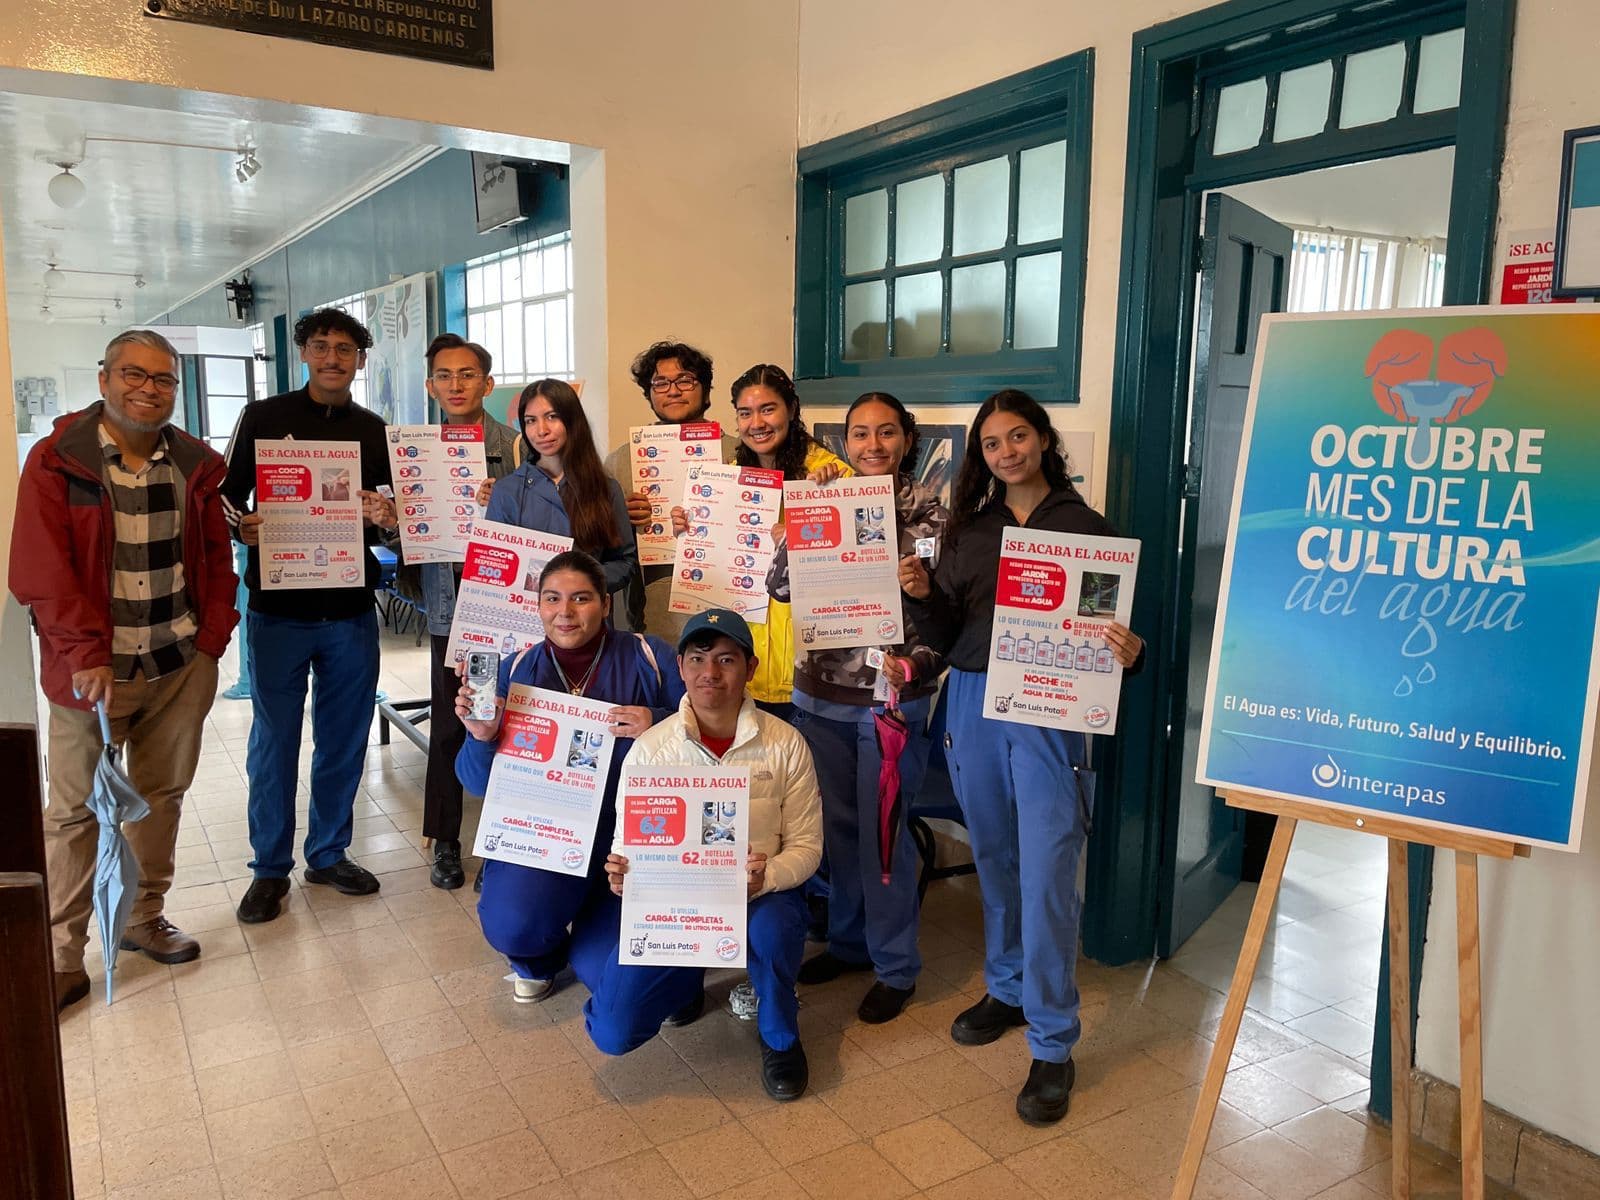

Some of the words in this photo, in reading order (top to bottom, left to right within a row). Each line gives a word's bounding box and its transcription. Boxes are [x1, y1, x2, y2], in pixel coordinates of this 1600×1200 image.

[376, 0, 456, 24] REPUBLICA
[459, 14, 477, 28] EL
[299, 5, 370, 32] LAZARO
[374, 18, 469, 48] CARDENAS.
[1509, 244, 1531, 256] ¡SE
[258, 449, 274, 458] ¡SE
[277, 450, 310, 458] ACABA
[328, 451, 358, 459] AGUA!
[1310, 424, 1546, 474] OCTUBRE
[786, 490, 803, 500] ¡SE
[805, 489, 840, 500] ACABA
[843, 488, 856, 497] EL
[858, 485, 891, 496] AGUA!
[1304, 472, 1395, 523] MES
[1406, 476, 1466, 527] DE
[1476, 479, 1534, 531] LA
[309, 506, 325, 516] 30
[473, 527, 489, 538] ¡SE
[490, 532, 523, 545] ACABA
[525, 538, 537, 549] EL
[801, 524, 824, 540] 62
[810, 540, 833, 548] AGUA
[841, 552, 856, 562] 62
[1005, 539, 1025, 552] ¡SE
[1027, 543, 1072, 558] ACABA
[1075, 548, 1091, 560] EL
[1093, 550, 1135, 564] AGUA!
[1297, 526, 1526, 586] CULTURA
[478, 566, 502, 578] 500
[1020, 582, 1045, 597] 120
[508, 593, 524, 604] 30
[1031, 596, 1053, 607] AGUA
[1284, 550, 1375, 616] del
[1378, 582, 1526, 656] agua
[842, 604, 881, 612] COMPLETAS
[1007, 616, 1020, 625] QUE
[1022, 618, 1051, 629] EQUIVALE
[1062, 618, 1072, 630] 6
[463, 632, 494, 644] CUBETA
[1024, 674, 1059, 686] NOCHE
[1023, 689, 1043, 697] AGUA
[1055, 694, 1078, 702] REUSO
[510, 693, 527, 706] ¡SE
[528, 698, 565, 714] ACABA
[567, 706, 581, 717] EL
[1013, 701, 1027, 709] San
[1028, 704, 1042, 712] Luis
[524, 716, 551, 727] CARGA
[1223, 695, 1236, 710] El
[1238, 698, 1276, 717] Agua
[1280, 706, 1301, 720] es:
[1305, 707, 1344, 729] Vida,
[1348, 714, 1404, 738] Futuro,
[1408, 722, 1456, 744] Salud
[1459, 733, 1470, 750] y
[1474, 732, 1567, 760] Equilibrio.
[513, 731, 538, 750] 62
[519, 750, 543, 761] AGUA
[546, 770, 563, 782] 62
[628, 777, 647, 788] ¡SE
[649, 777, 690, 788] ACABA
[692, 778, 707, 788] EL
[710, 777, 747, 788] AGUA!
[1341, 769, 1446, 807] interapas
[647, 798, 677, 806] CARGA
[502, 817, 532, 828] CARGAS
[534, 823, 574, 837] COMPLETAS
[640, 816, 667, 835] 62
[501, 840, 514, 849] San
[514, 842, 527, 851] Luis
[649, 836, 675, 844] AGUA
[681, 852, 700, 865] 62
[645, 915, 678, 923] CARGAS
[680, 915, 724, 924] COMPLETAS
[662, 942, 676, 950] Luis
